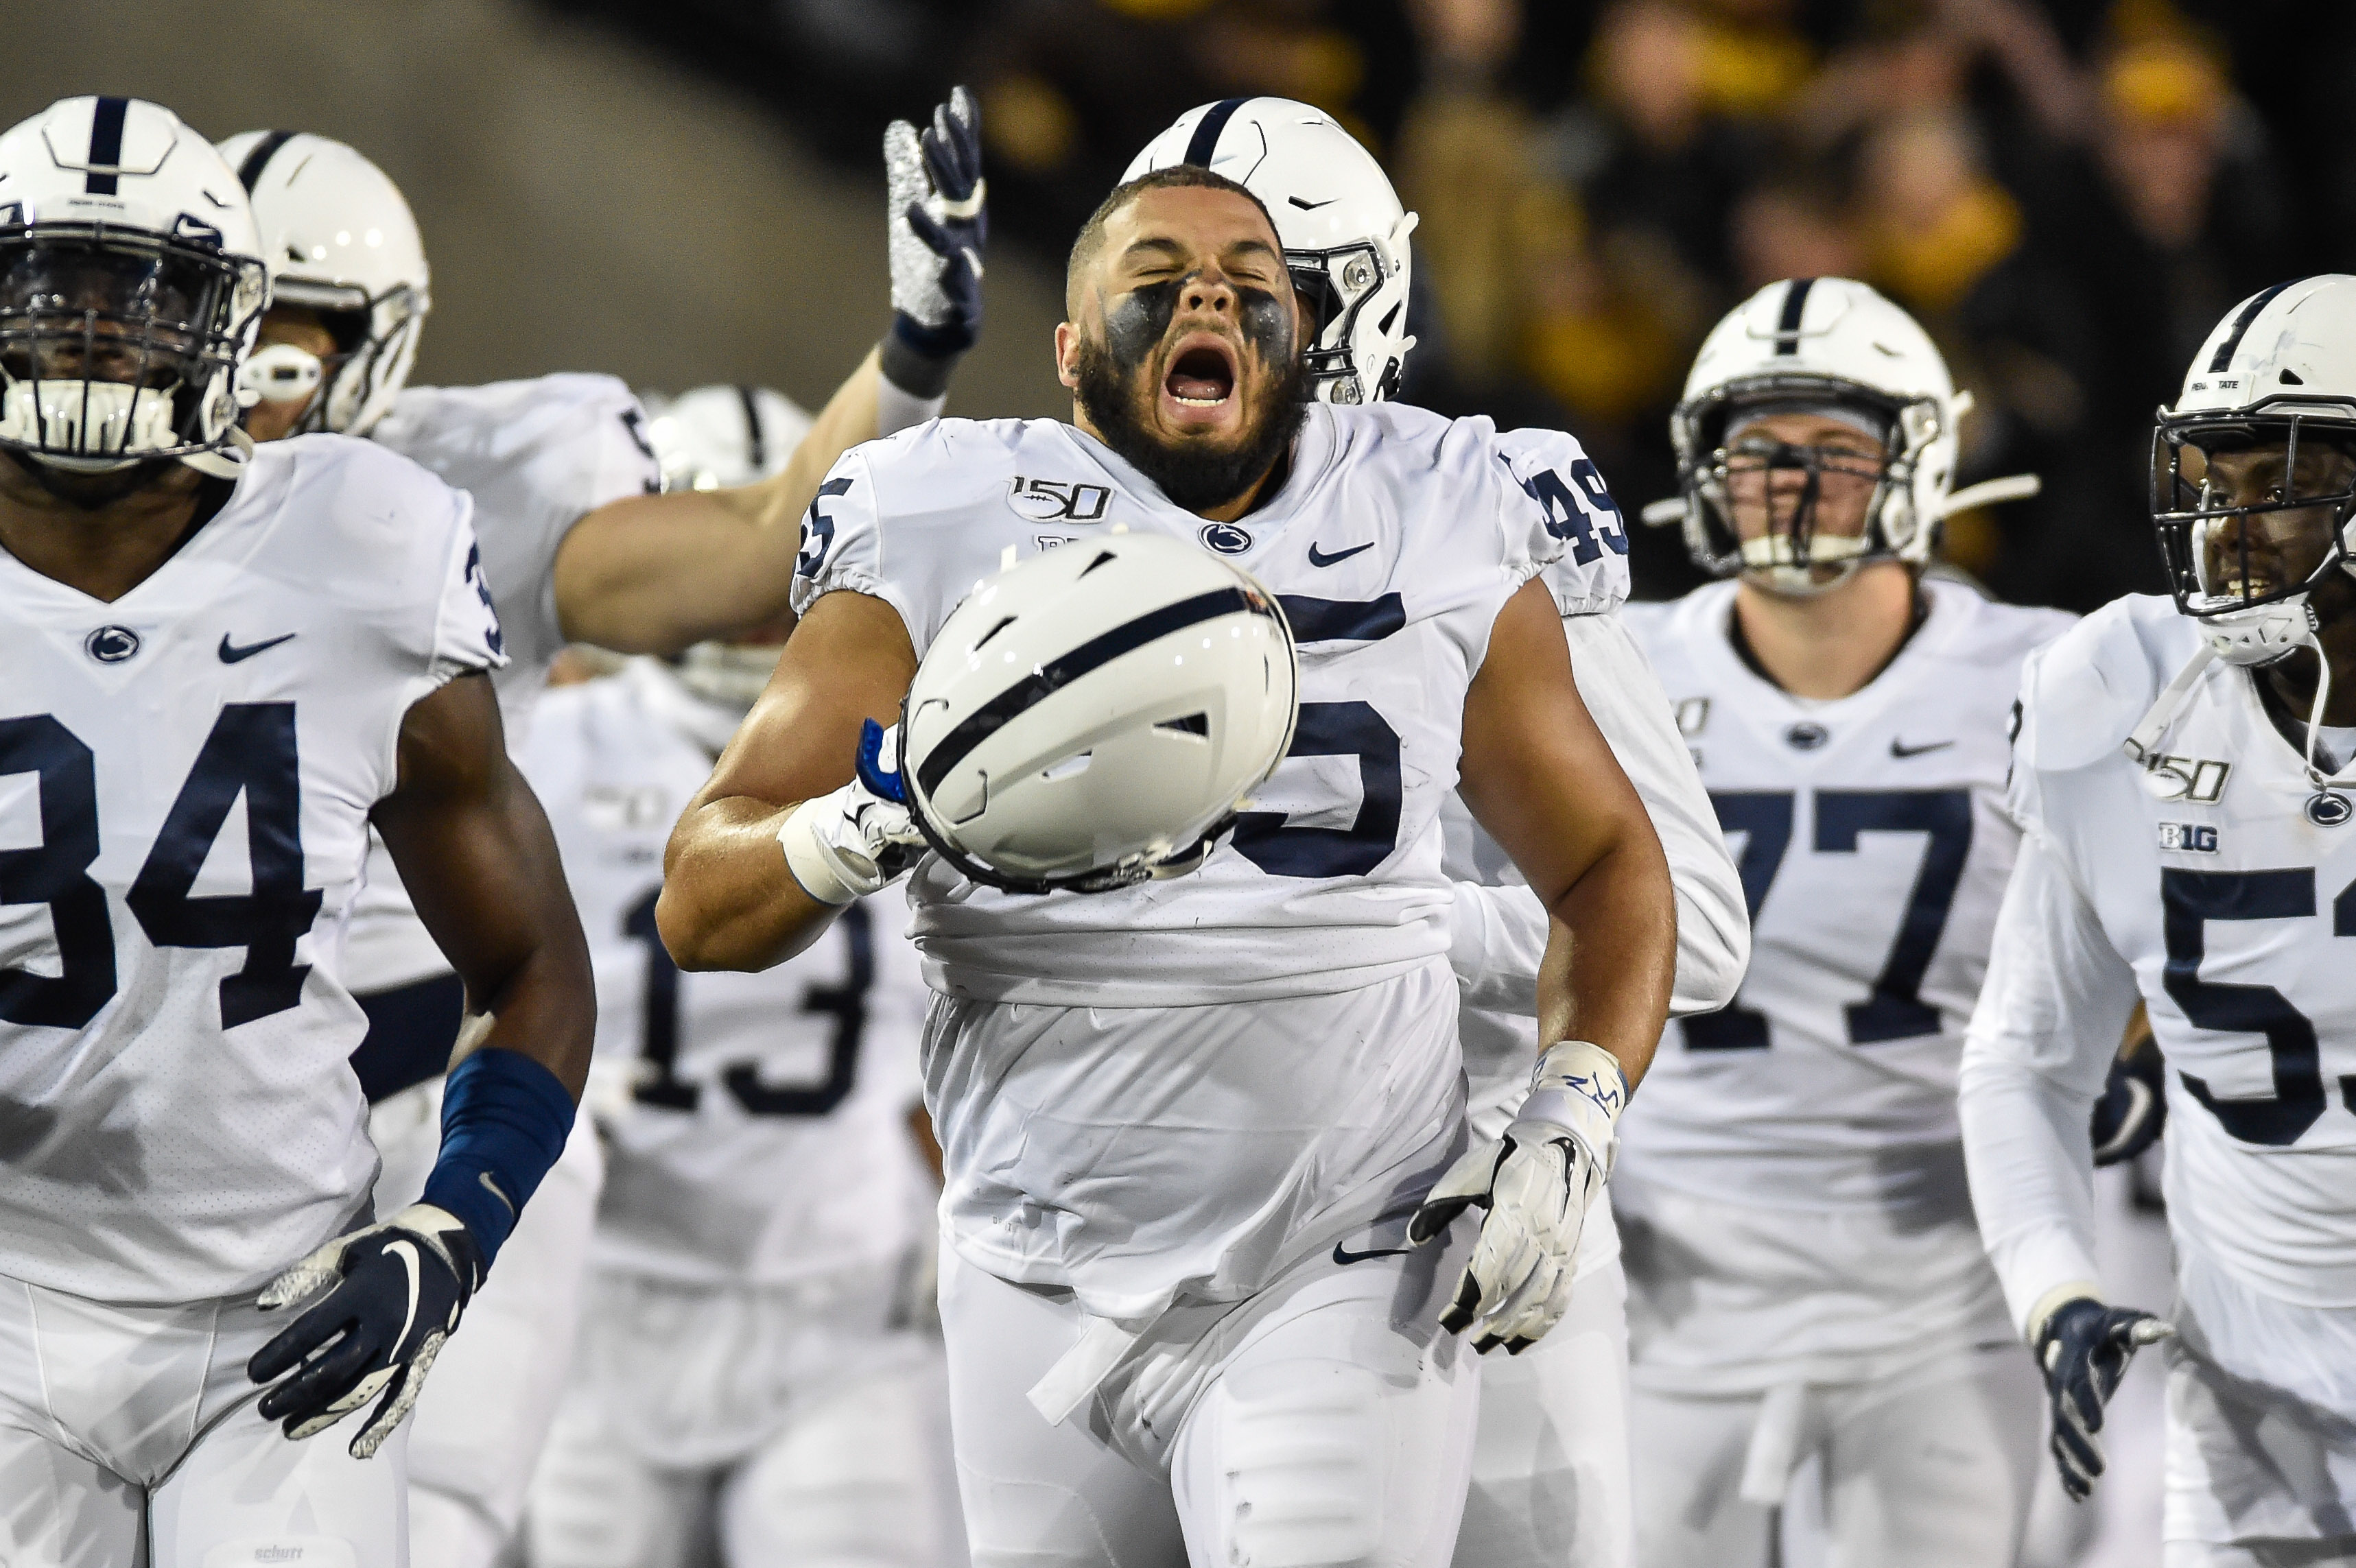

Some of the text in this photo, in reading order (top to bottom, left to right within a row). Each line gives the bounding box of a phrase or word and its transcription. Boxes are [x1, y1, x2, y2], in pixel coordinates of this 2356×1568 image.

[2217, 380, 2239, 390] TATE
[1013, 475, 1111, 519] 150
[1530, 458, 1629, 567] 49
[1229, 591, 1406, 878] 5
[2147, 752, 2230, 802] 150
[1678, 787, 1973, 1052] 77
[2160, 866, 2356, 1145] 5
